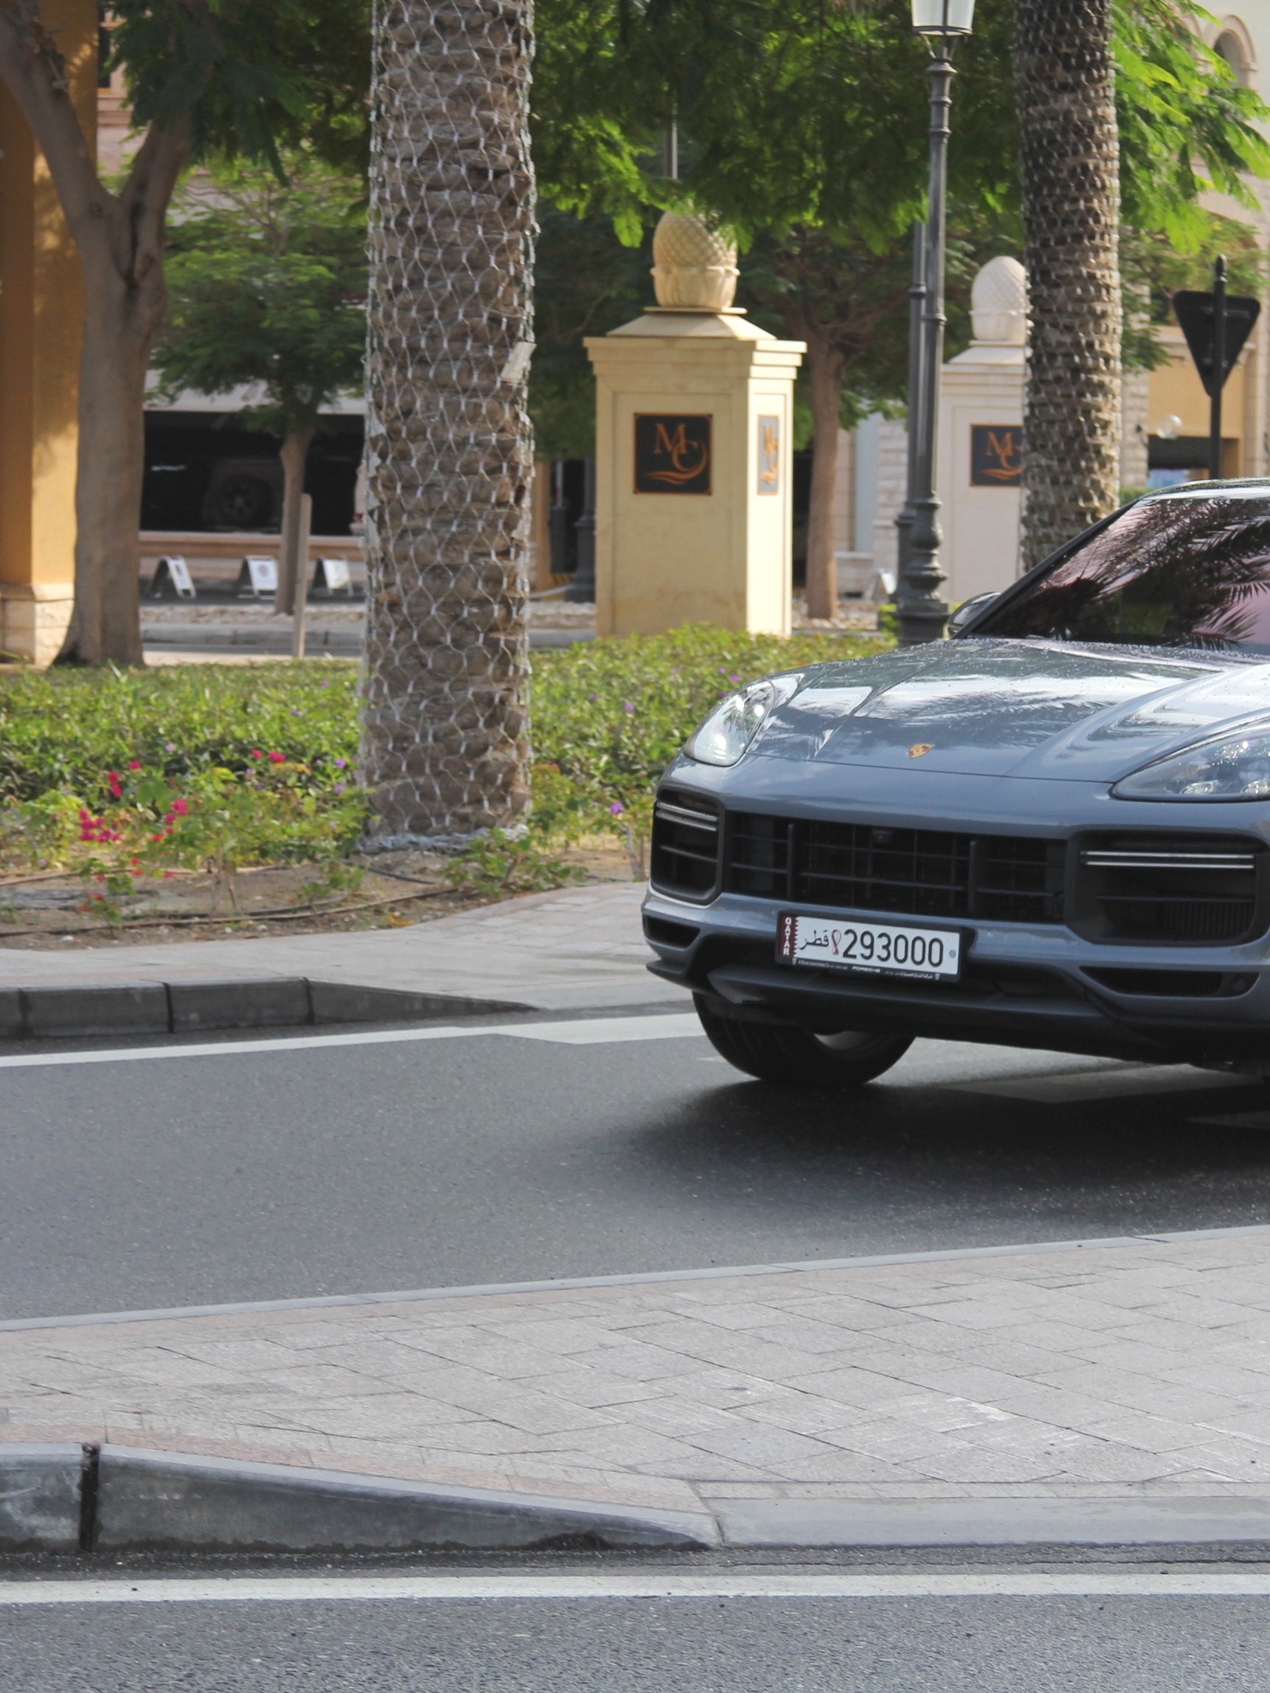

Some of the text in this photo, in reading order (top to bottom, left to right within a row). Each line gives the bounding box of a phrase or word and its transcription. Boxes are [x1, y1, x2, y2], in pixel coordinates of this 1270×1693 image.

[783, 917, 792, 956] QATAR
[799, 928, 944, 968] قطر 293000
